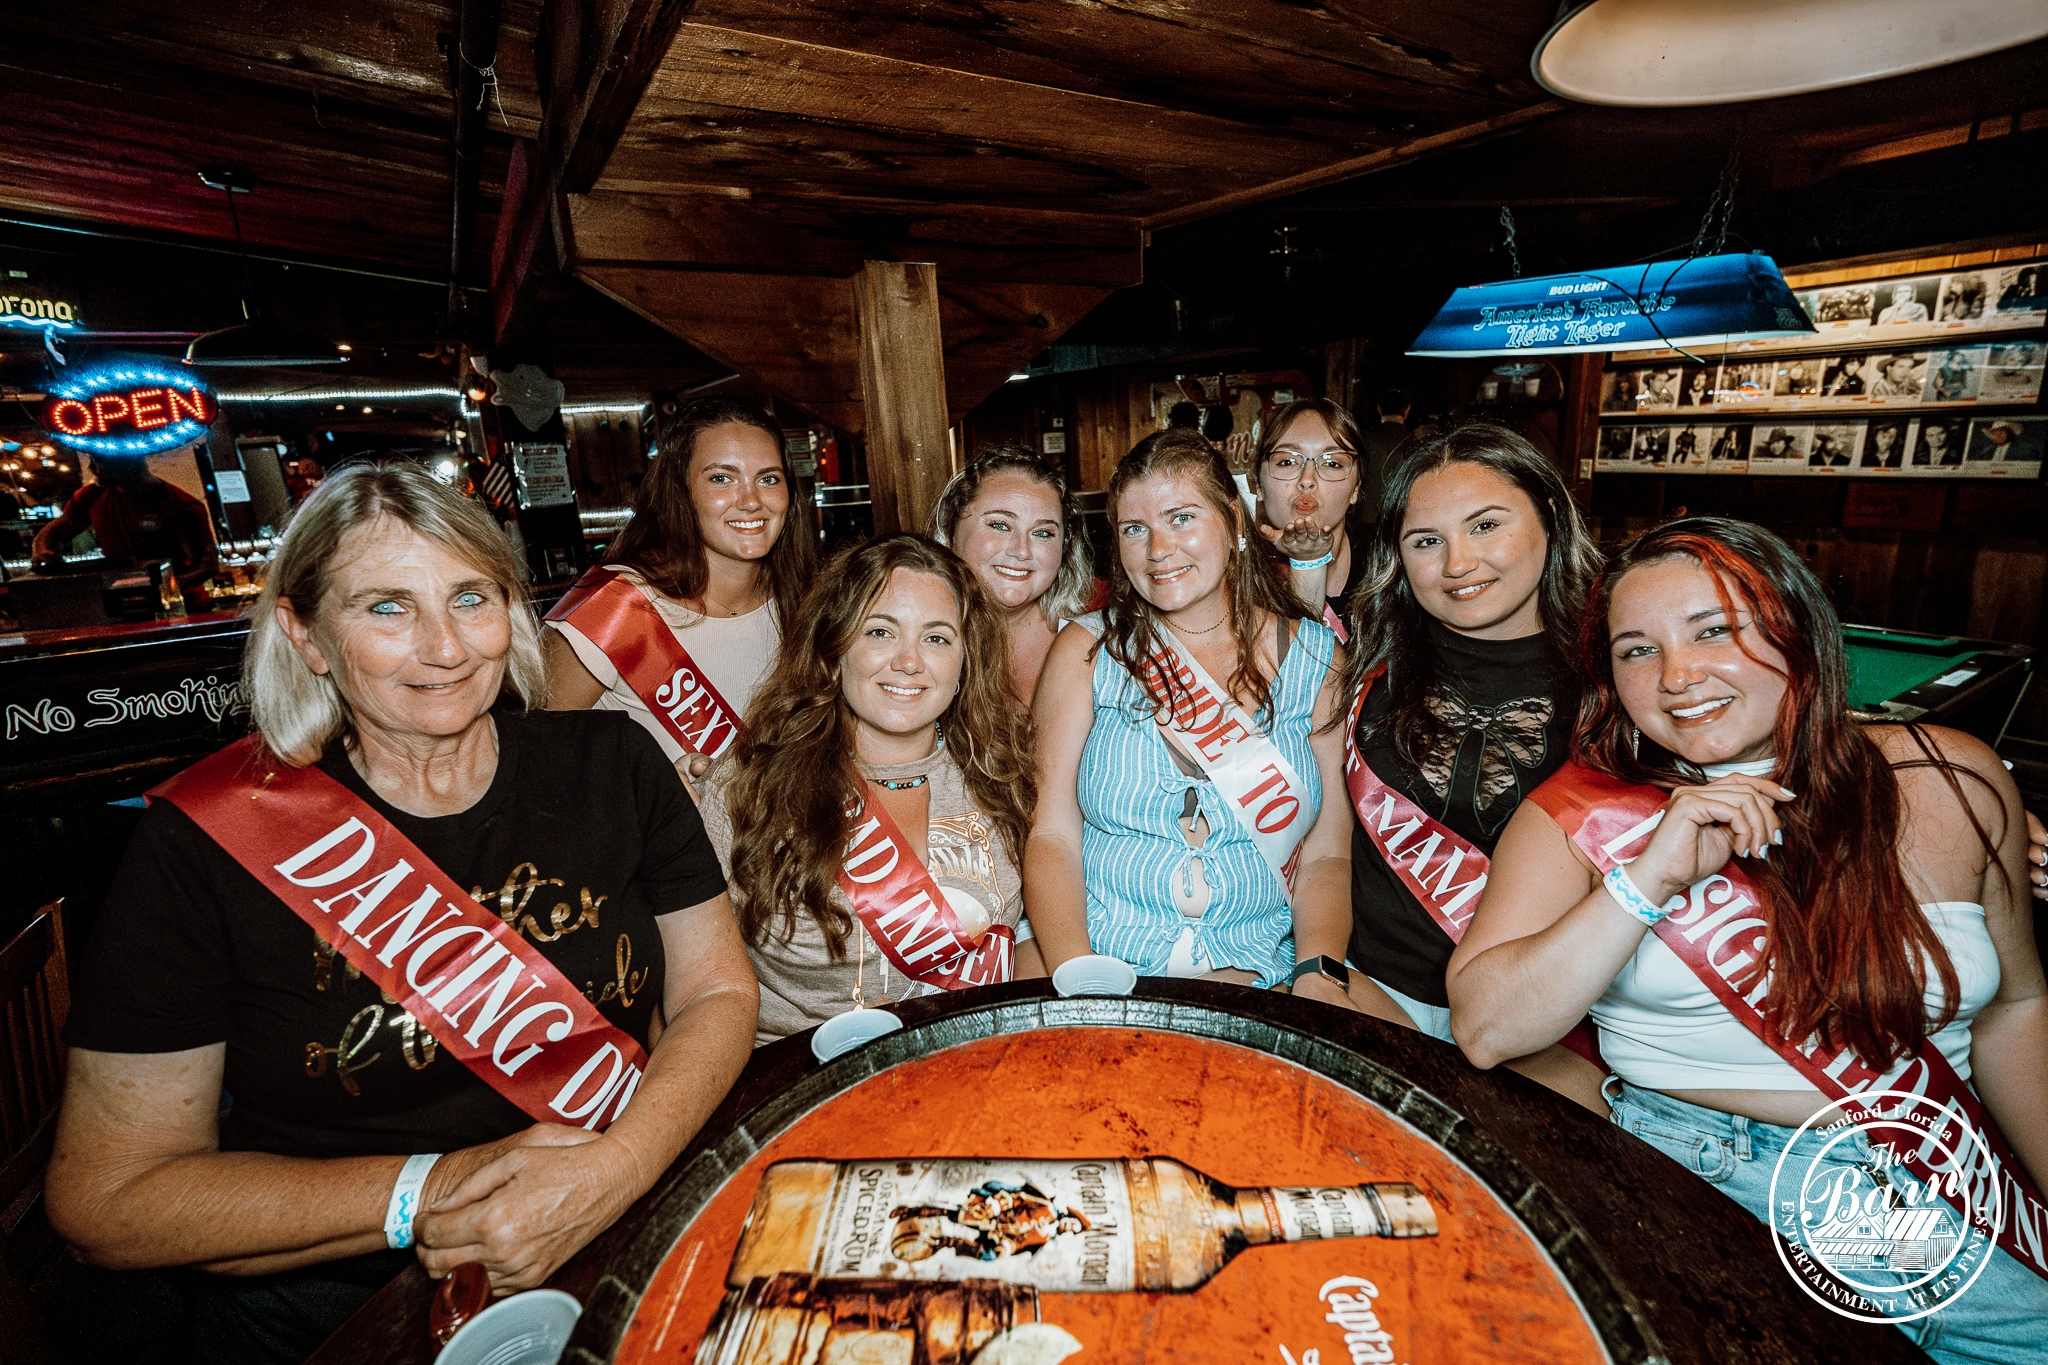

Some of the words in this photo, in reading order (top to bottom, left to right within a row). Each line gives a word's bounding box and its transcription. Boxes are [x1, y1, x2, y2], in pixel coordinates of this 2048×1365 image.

[0, 295, 73, 321] rona
[1473, 301, 1576, 331] America's
[1549, 285, 1575, 296] BUD
[1575, 281, 1608, 294] LIGHT
[1505, 323, 1560, 349] Light
[1564, 320, 1627, 346] Lager
[54, 386, 206, 435] OPEN
[6, 698, 76, 741] No
[83, 675, 252, 723] Smokin
[1140, 645, 1252, 763] BRIDE
[1237, 762, 1301, 834] TO
[1363, 792, 1489, 929] MAM
[273, 816, 575, 1077] DANCING
[853, 1168, 883, 1229] SPICED
[1071, 1163, 1115, 1215] Captain
[1276, 1186, 1323, 1241] Morgan
[1316, 1187, 1360, 1239] Captain
[1917, 1096, 2048, 1273] DRUN
[867, 1181, 894, 1259] ORIGINAL
[836, 1231, 869, 1275] RUM
[1077, 1216, 1118, 1286] Morgan
[1319, 1275, 1409, 1365] Capta
